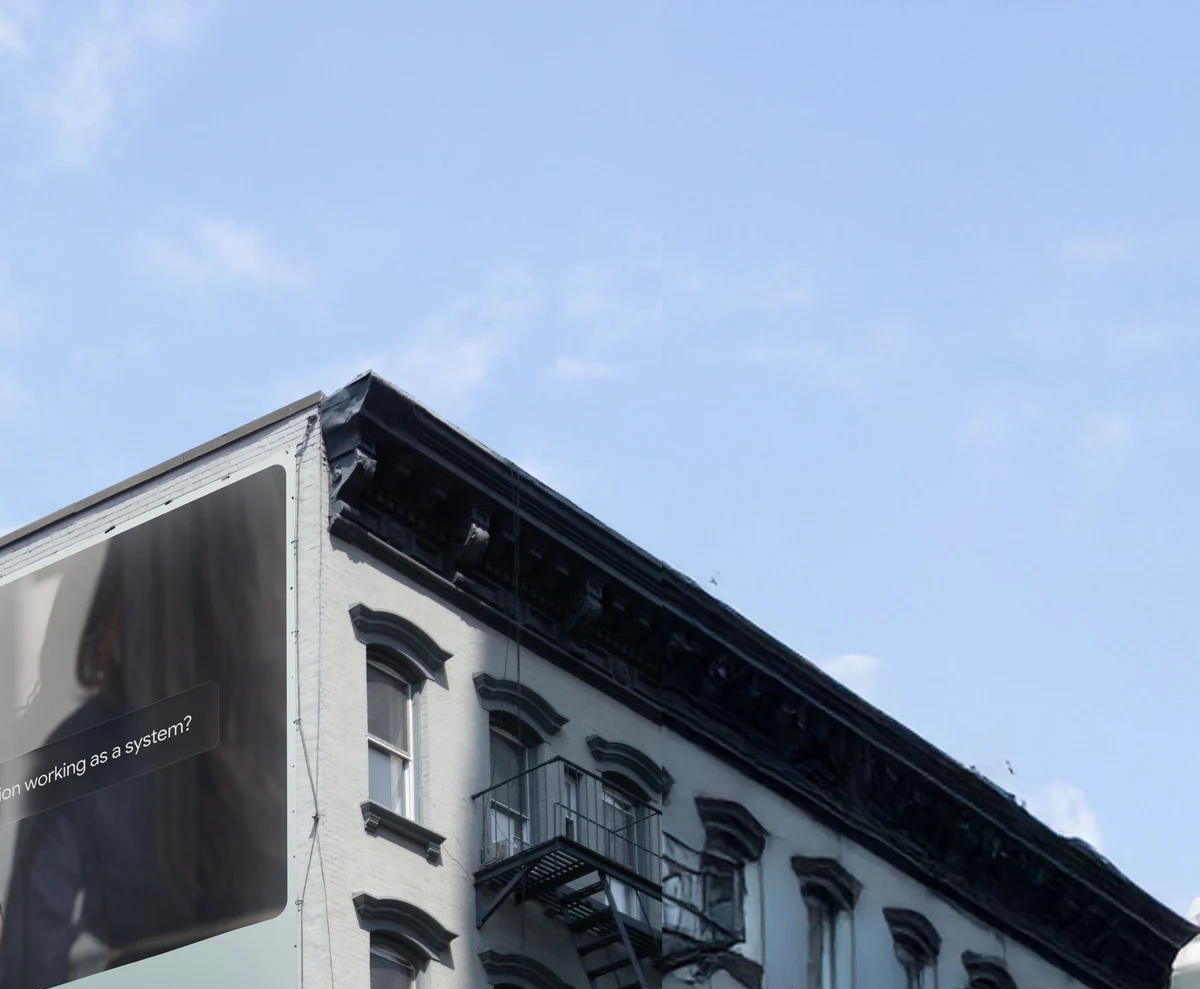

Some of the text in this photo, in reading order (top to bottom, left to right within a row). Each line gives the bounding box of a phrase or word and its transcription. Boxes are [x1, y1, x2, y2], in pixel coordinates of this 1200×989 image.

[25, 758, 87, 792] working
[90, 751, 109, 768] as
[112, 746, 122, 760] a
[125, 714, 193, 756] system?
